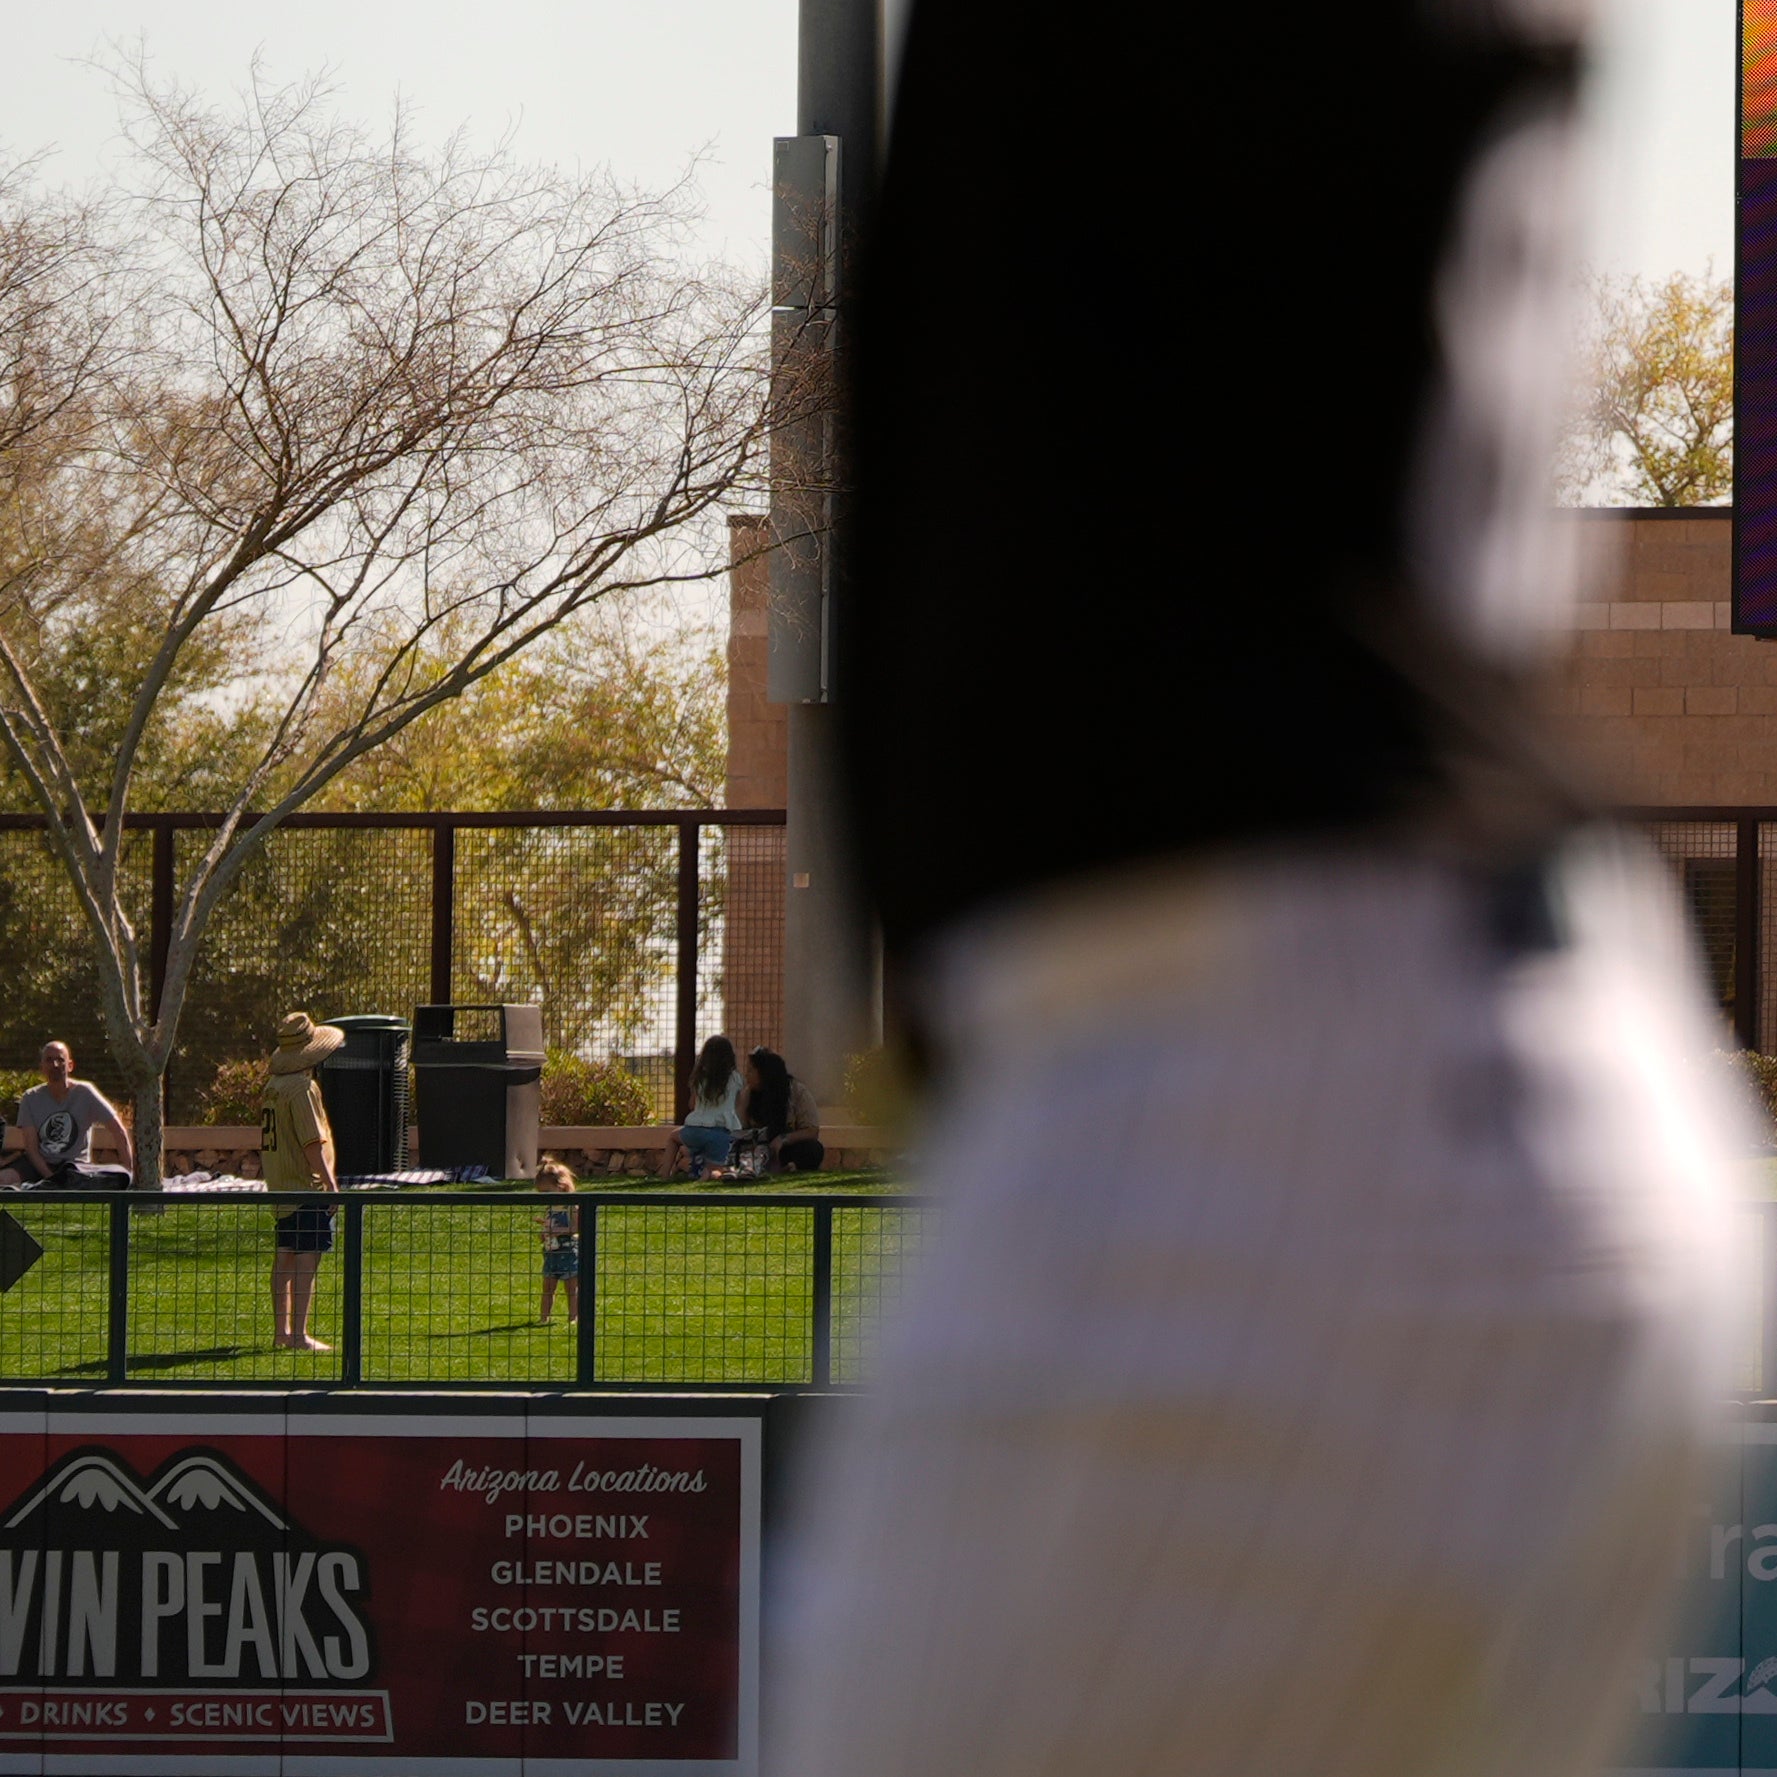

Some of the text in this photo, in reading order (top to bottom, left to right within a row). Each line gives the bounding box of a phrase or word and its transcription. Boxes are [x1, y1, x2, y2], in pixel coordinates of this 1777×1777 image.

[440, 1460, 707, 1504] Arizona Locations
[505, 1514, 649, 1540] PHOENIX
[491, 1561, 662, 1587] GLENDALE
[141, 1551, 370, 1680] PEAKS
[471, 1607, 681, 1633] SCOTTSDALE
[517, 1654, 624, 1679] TEMPE
[20, 1702, 375, 1728] DRINKS SCENIC VIEWS
[466, 1700, 685, 1727] DEER VALLEY
